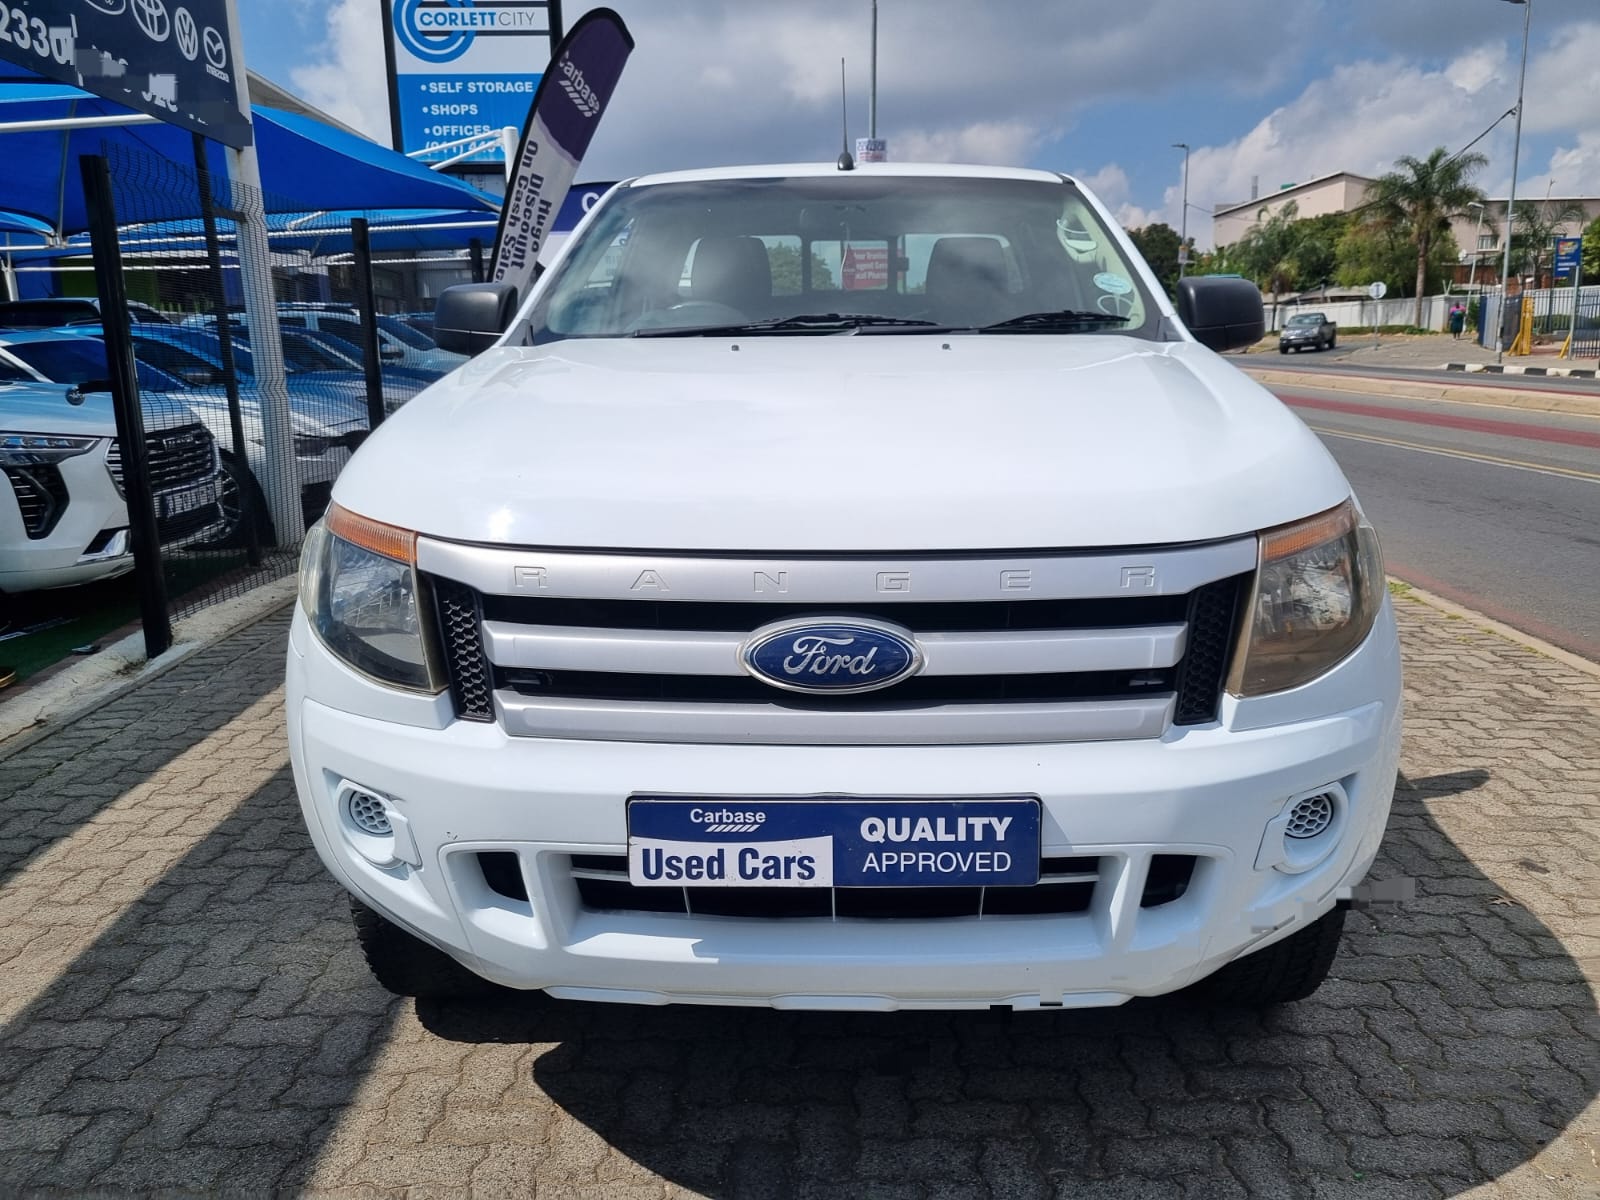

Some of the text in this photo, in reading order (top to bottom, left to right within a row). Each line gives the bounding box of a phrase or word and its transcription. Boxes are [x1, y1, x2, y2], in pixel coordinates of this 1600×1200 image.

[419, 11, 535, 27] CORLETT CITY
[428, 81, 534, 93] SELF STORAGE
[430, 103, 479, 116] SHOPS
[432, 124, 491, 137] OFFICES
[521, 139, 539, 168] On
[507, 174, 529, 228] Cash
[510, 172, 545, 270] Discount
[513, 564, 1156, 594] RANGER
[783, 635, 879, 675] Ford
[689, 808, 766, 825] Carbase
[860, 816, 1013, 843] QUALITY
[641, 847, 816, 881] Used Cars
[862, 851, 1012, 874] APPROVED
